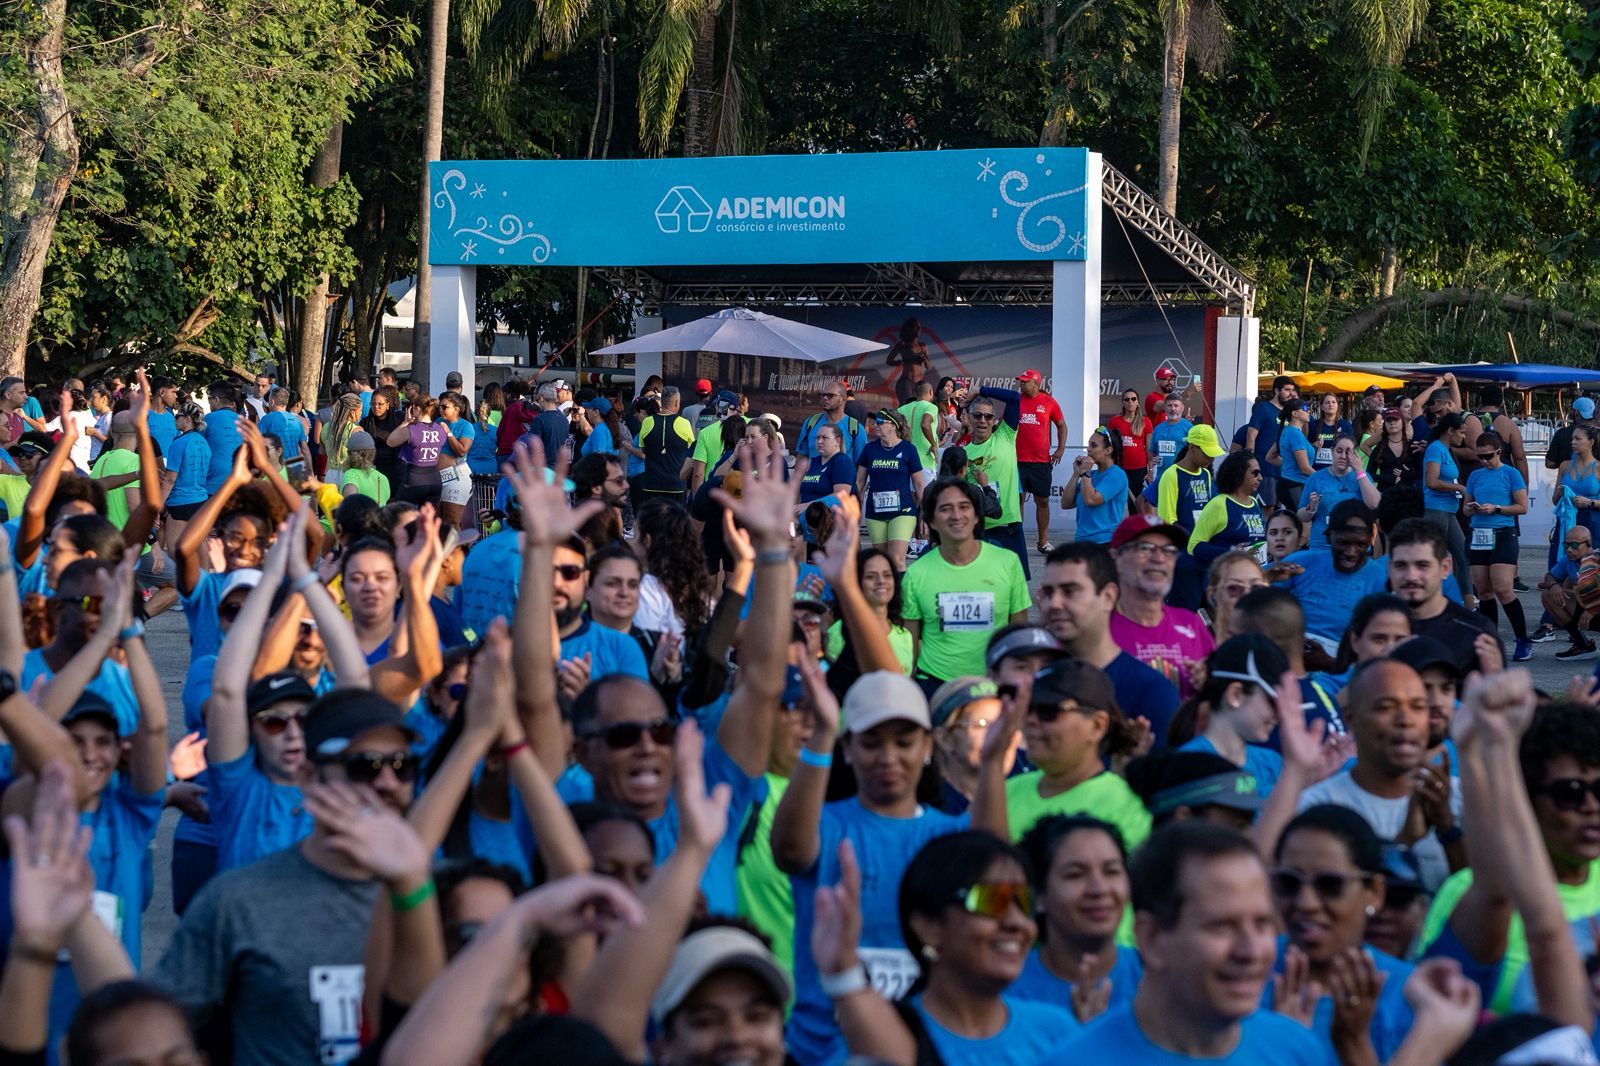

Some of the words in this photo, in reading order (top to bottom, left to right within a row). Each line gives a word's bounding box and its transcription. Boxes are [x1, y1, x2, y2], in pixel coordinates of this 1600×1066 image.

[716, 195, 846, 220] ADEMICON
[716, 221, 765, 232] consórcio
[767, 223, 774, 232] e
[776, 220, 846, 232] investimento
[421, 430, 440, 443] FR
[420, 447, 439, 460] TS
[872, 459, 899, 467] GIGANTE
[952, 603, 981, 621] 4124
